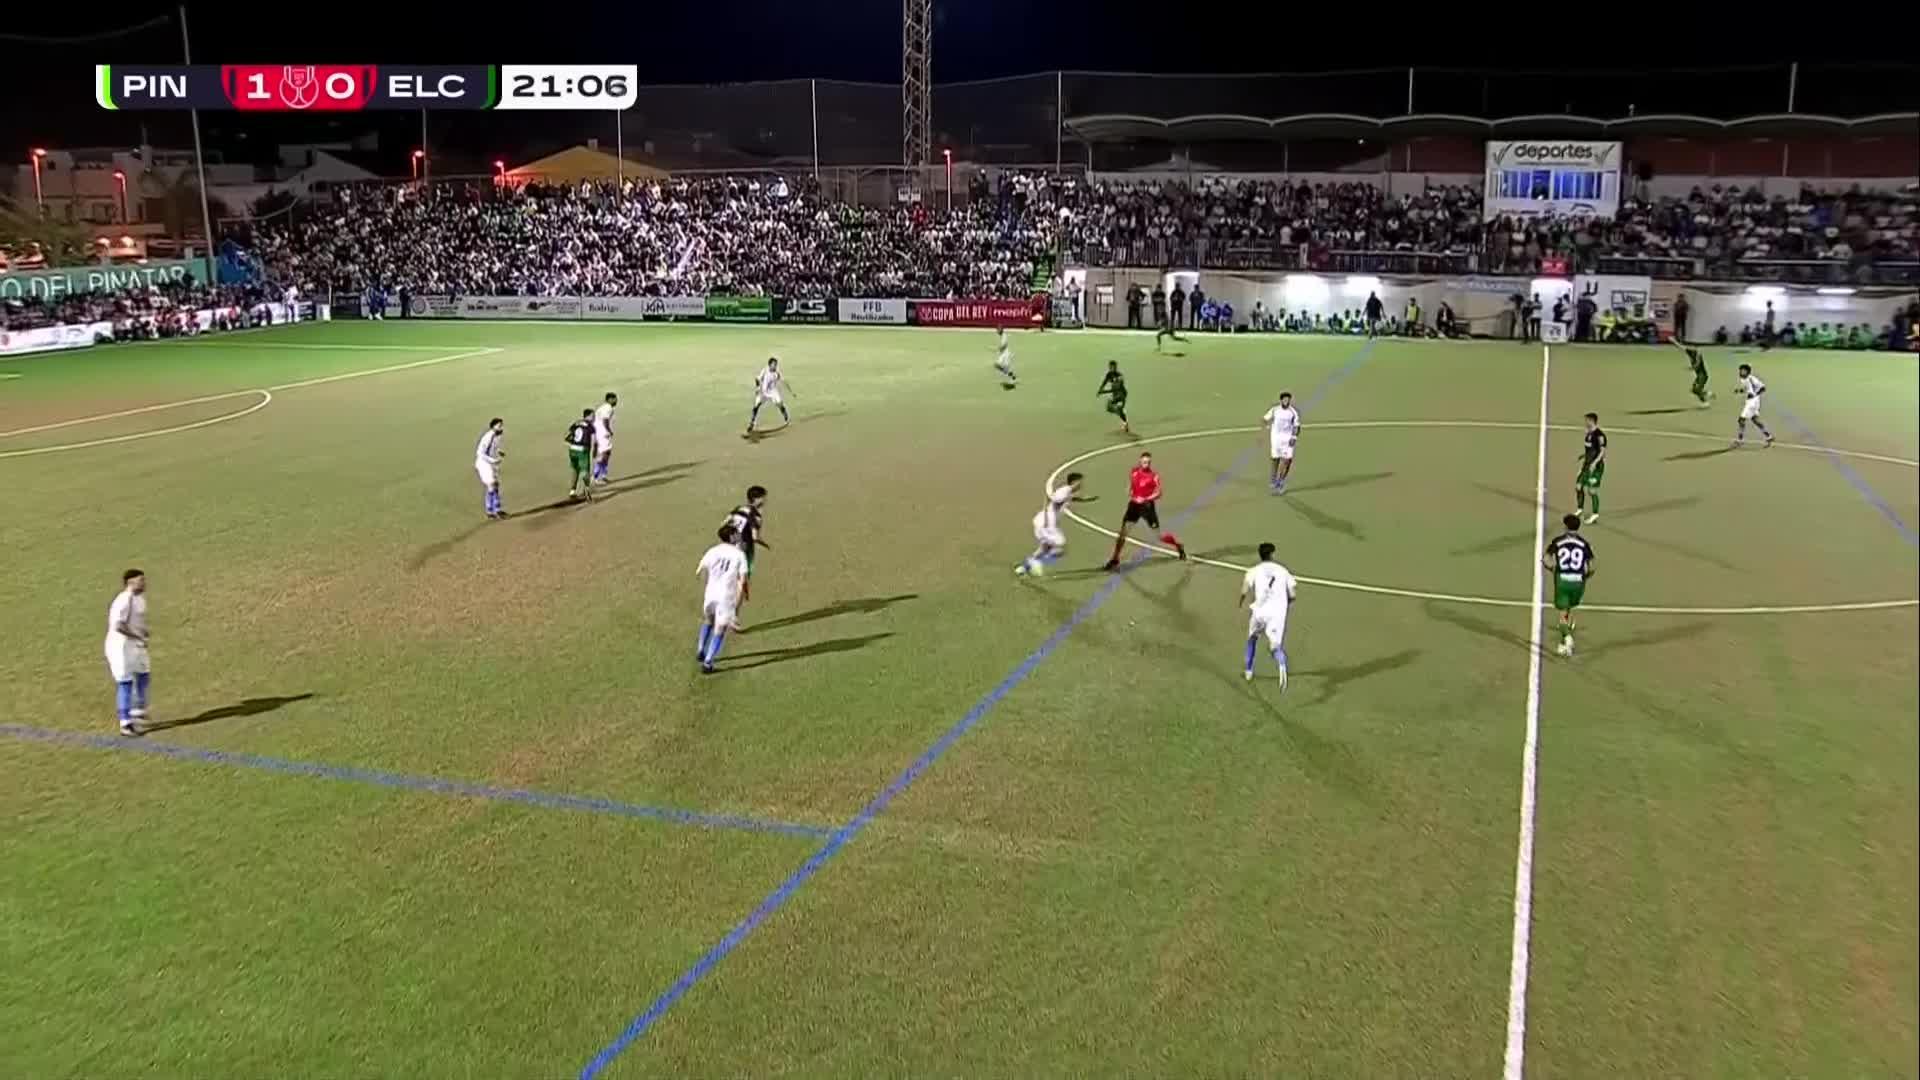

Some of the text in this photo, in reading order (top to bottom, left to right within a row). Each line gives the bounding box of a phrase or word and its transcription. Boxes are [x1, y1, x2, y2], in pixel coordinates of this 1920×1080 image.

[1514, 144, 1593, 160] deportes
[30, 273, 74, 301] DEL
[87, 265, 186, 294] PINATAR
[932, 308, 954, 320] COPA
[956, 305, 970, 319] DEL
[972, 305, 988, 319] REY
[1557, 547, 1584, 571] 29
[1265, 574, 1276, 589] 7
